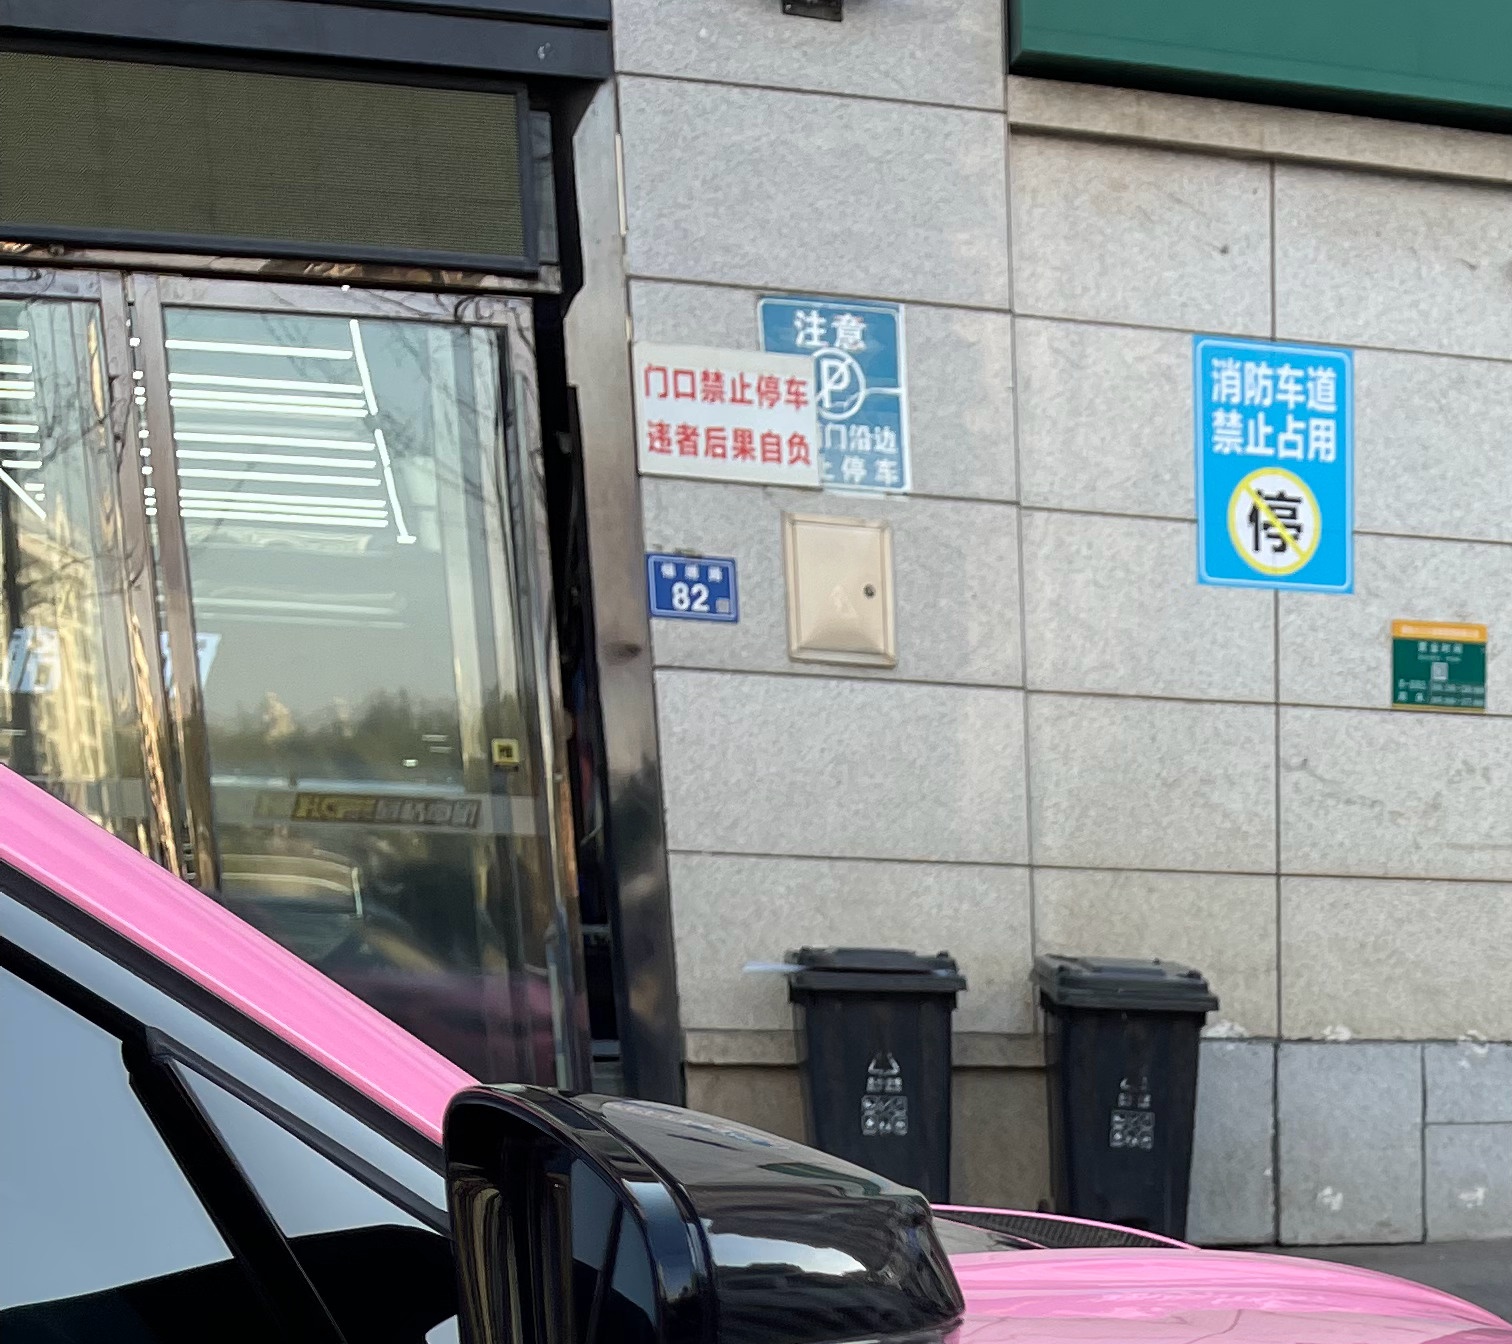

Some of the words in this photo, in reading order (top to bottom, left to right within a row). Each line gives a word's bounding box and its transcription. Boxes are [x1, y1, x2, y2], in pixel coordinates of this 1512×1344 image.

[793, 309, 867, 350] 注意
[643, 363, 809, 410] 门口禁止停车
[1211, 357, 1338, 413] 消防车道
[646, 420, 812, 467] 违者后果自负
[1211, 409, 1338, 463] 禁止占用
[671, 581, 711, 612] 82
